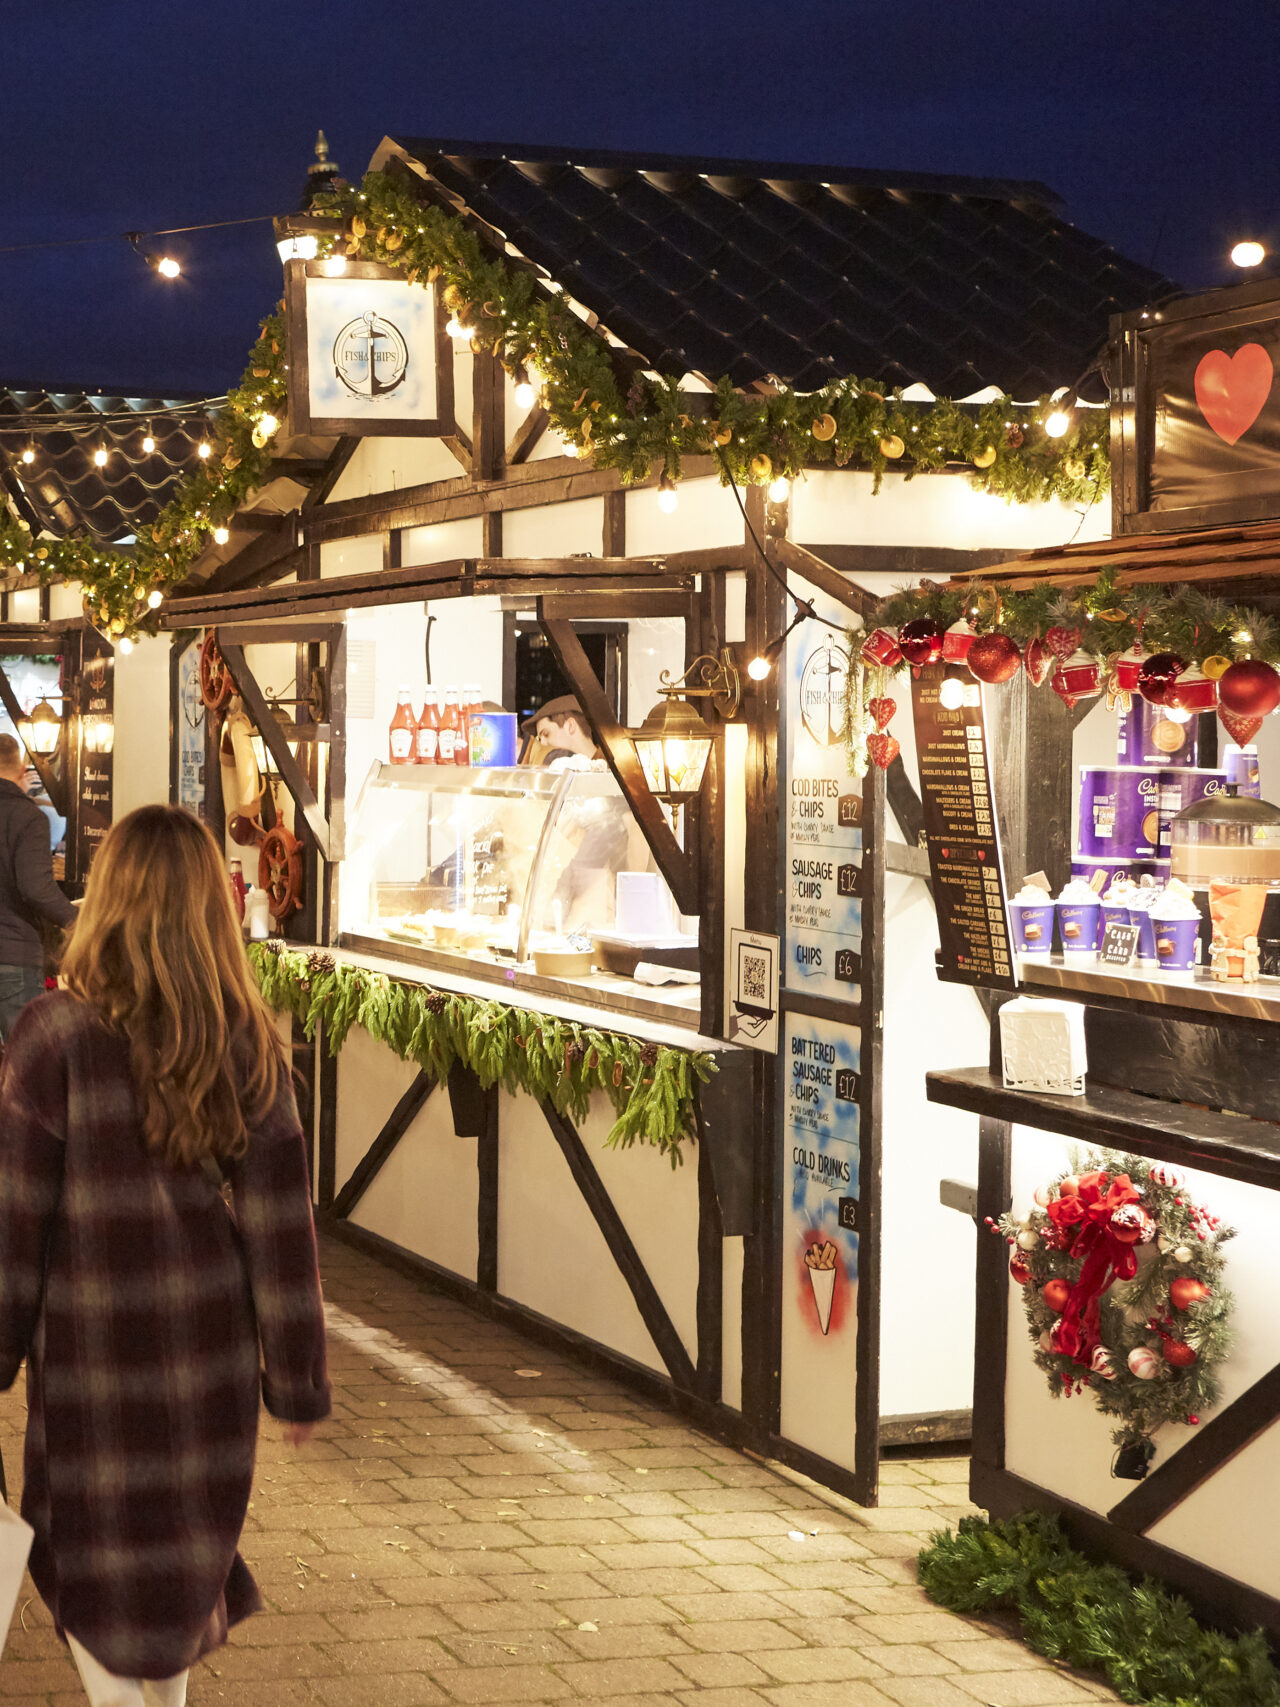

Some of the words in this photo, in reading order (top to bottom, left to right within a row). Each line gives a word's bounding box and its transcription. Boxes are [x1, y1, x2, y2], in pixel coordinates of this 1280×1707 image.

[345, 351, 364, 361] FISH
[374, 351, 396, 362] CHIPS
[807, 690, 821, 704] FISH
[792, 778, 810, 796] COD
[812, 779, 839, 798] BITES
[1138, 779, 1159, 795] Cad
[1204, 780, 1227, 796] Cad
[800, 801, 824, 818] CHIPS
[841, 801, 858, 820] £12
[792, 859, 833, 880] SAUSAGE
[840, 869, 857, 892] £12
[798, 881, 822, 900] CHIPS
[1111, 929, 1131, 941] CASH
[796, 945, 822, 966] CHIPS
[1107, 944, 1128, 956] CARD
[839, 956, 852, 975] £6
[792, 1036, 835, 1065] BATTERED
[793, 1061, 832, 1086] SAUSAGE
[796, 1084, 819, 1104] CHIPS
[839, 1075, 856, 1100] £12
[793, 1147, 815, 1170] COLD
[818, 1153, 850, 1182] DRINKS
[843, 1206, 856, 1225] £3
